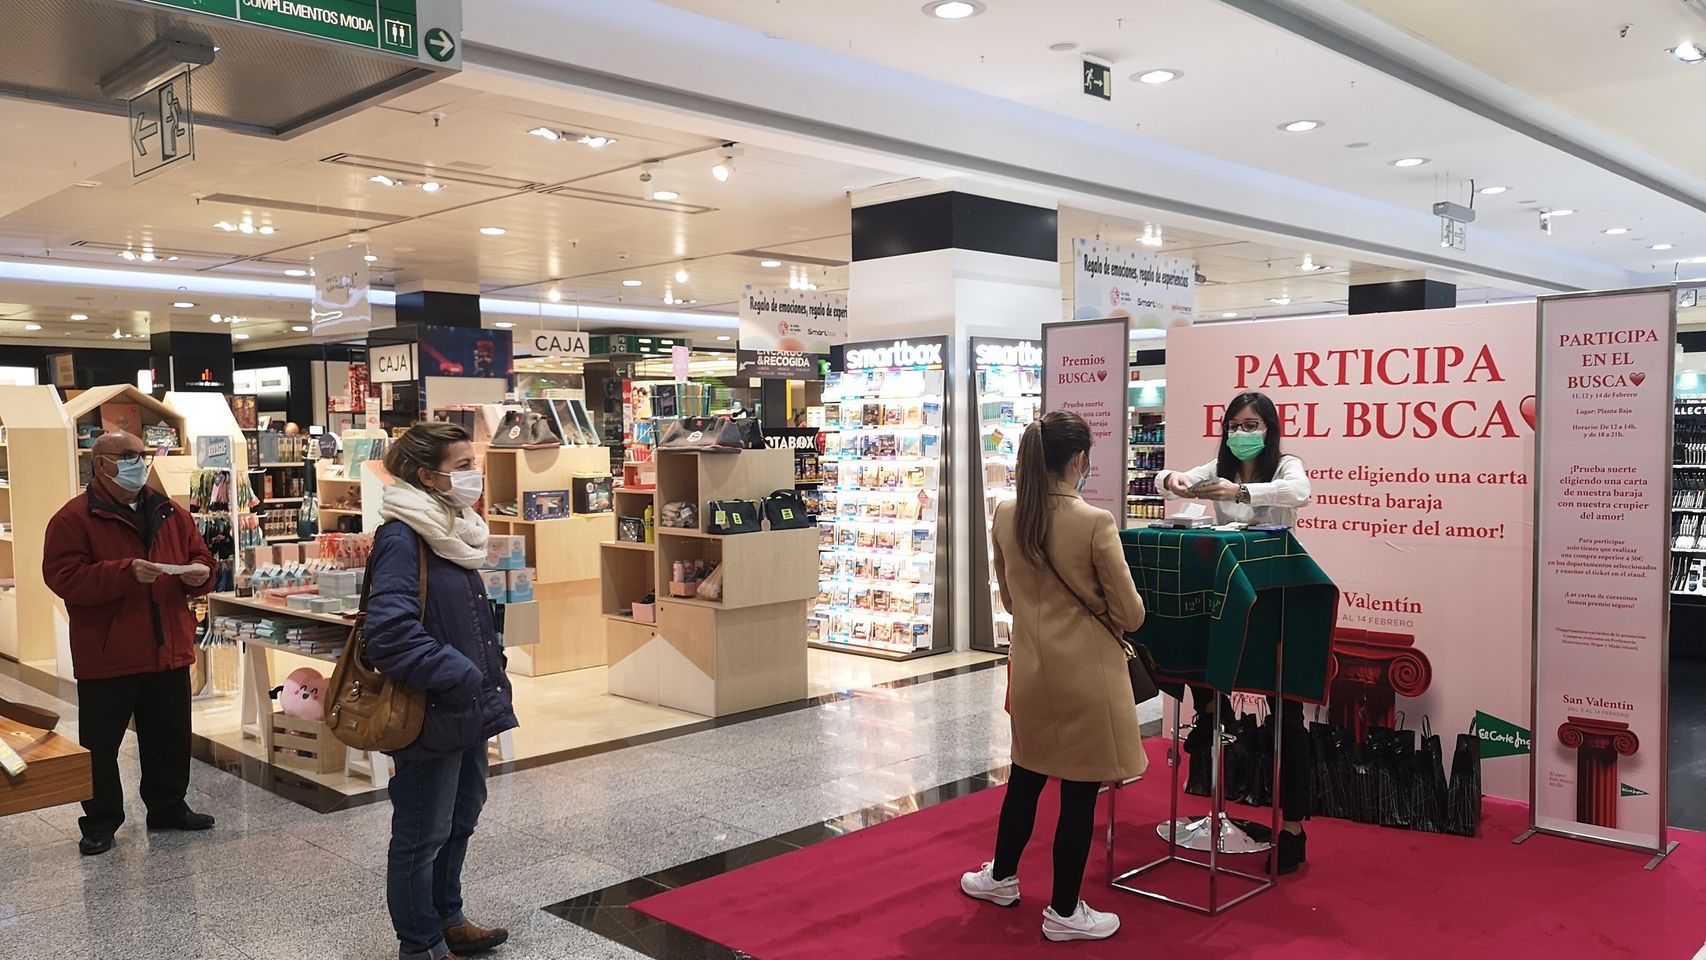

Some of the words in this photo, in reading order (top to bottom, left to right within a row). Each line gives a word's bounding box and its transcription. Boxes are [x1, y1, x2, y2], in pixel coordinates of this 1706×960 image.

[339, 13, 375, 32] MODA
[1084, 253, 1103, 278] Regalo
[1104, 256, 1110, 275] de
[1111, 260, 1139, 283] emociones,
[1140, 265, 1154, 286] regalo
[1155, 266, 1161, 284] de
[1162, 269, 1189, 289] experiencias
[750, 296, 770, 315] Regalo
[771, 298, 778, 312] de
[779, 299, 809, 317] emociones,
[809, 302, 825, 319] regalo
[826, 303, 832, 316] de
[535, 335, 585, 353] CAJA
[1559, 328, 1659, 347] PARTICIPA
[756, 356, 811, 367] &RECOGIDA
[846, 340, 943, 369] smartbox
[1062, 354, 1106, 367] Premios
[1582, 353, 1607, 367] EN
[1611, 352, 1635, 366] EL
[378, 355, 408, 373] CAJA
[1234, 344, 1505, 389] PARTICIPA
[1058, 371, 1097, 385] BUSCA
[1567, 374, 1628, 389] BUSCA
[1612, 390, 1638, 398] Febrero
[1576, 408, 1596, 416] Lugar:
[1618, 407, 1633, 415] Baja
[1202, 404, 1225, 438] E
[1278, 402, 1331, 438] EL
[1342, 400, 1520, 439] BUSCA
[1092, 429, 1112, 438] rupier
[764, 435, 815, 450] OTABOX
[1348, 465, 1431, 487] eligiendo
[1435, 471, 1471, 485] una
[1476, 470, 1528, 486] carta
[1570, 465, 1605, 474] ¡Prueba
[1560, 476, 1602, 487] eligiendo
[1624, 478, 1648, 486] carta
[1564, 488, 1575, 497] de
[1576, 489, 1612, 498] nuestra
[1613, 488, 1643, 500] baraja
[1316, 492, 1381, 509] nuestra
[1385, 492, 1443, 514] baraja
[1576, 501, 1611, 509] nuestra
[1613, 501, 1649, 511] crupier
[1580, 511, 1594, 520] del
[1596, 512, 1625, 521] amor!
[1296, 514, 1338, 531] estra
[1342, 517, 1407, 538] crupier
[1412, 518, 1440, 537] del
[1445, 523, 1505, 539] amor!
[1594, 538, 1625, 546] participar
[1573, 553, 1597, 561] compra
[1598, 554, 1625, 562] superior
[1566, 560, 1612, 570] departamentos
[1613, 562, 1657, 571] seleccionados
[1592, 569, 1610, 577] ticket
[1565, 591, 1577, 599] ¡Las
[1342, 591, 1424, 615] Valentín
[1587, 600, 1611, 608] premio
[1342, 613, 1354, 623] AL
[1357, 614, 1367, 624] 14
[1369, 616, 1414, 628] FEBRERO
[1563, 694, 1583, 705] San
[1586, 696, 1634, 711] Valentín
[1602, 710, 1630, 719] FEBRERO
[1478, 728, 1489, 740] El
[1489, 730, 1514, 744] Corte
